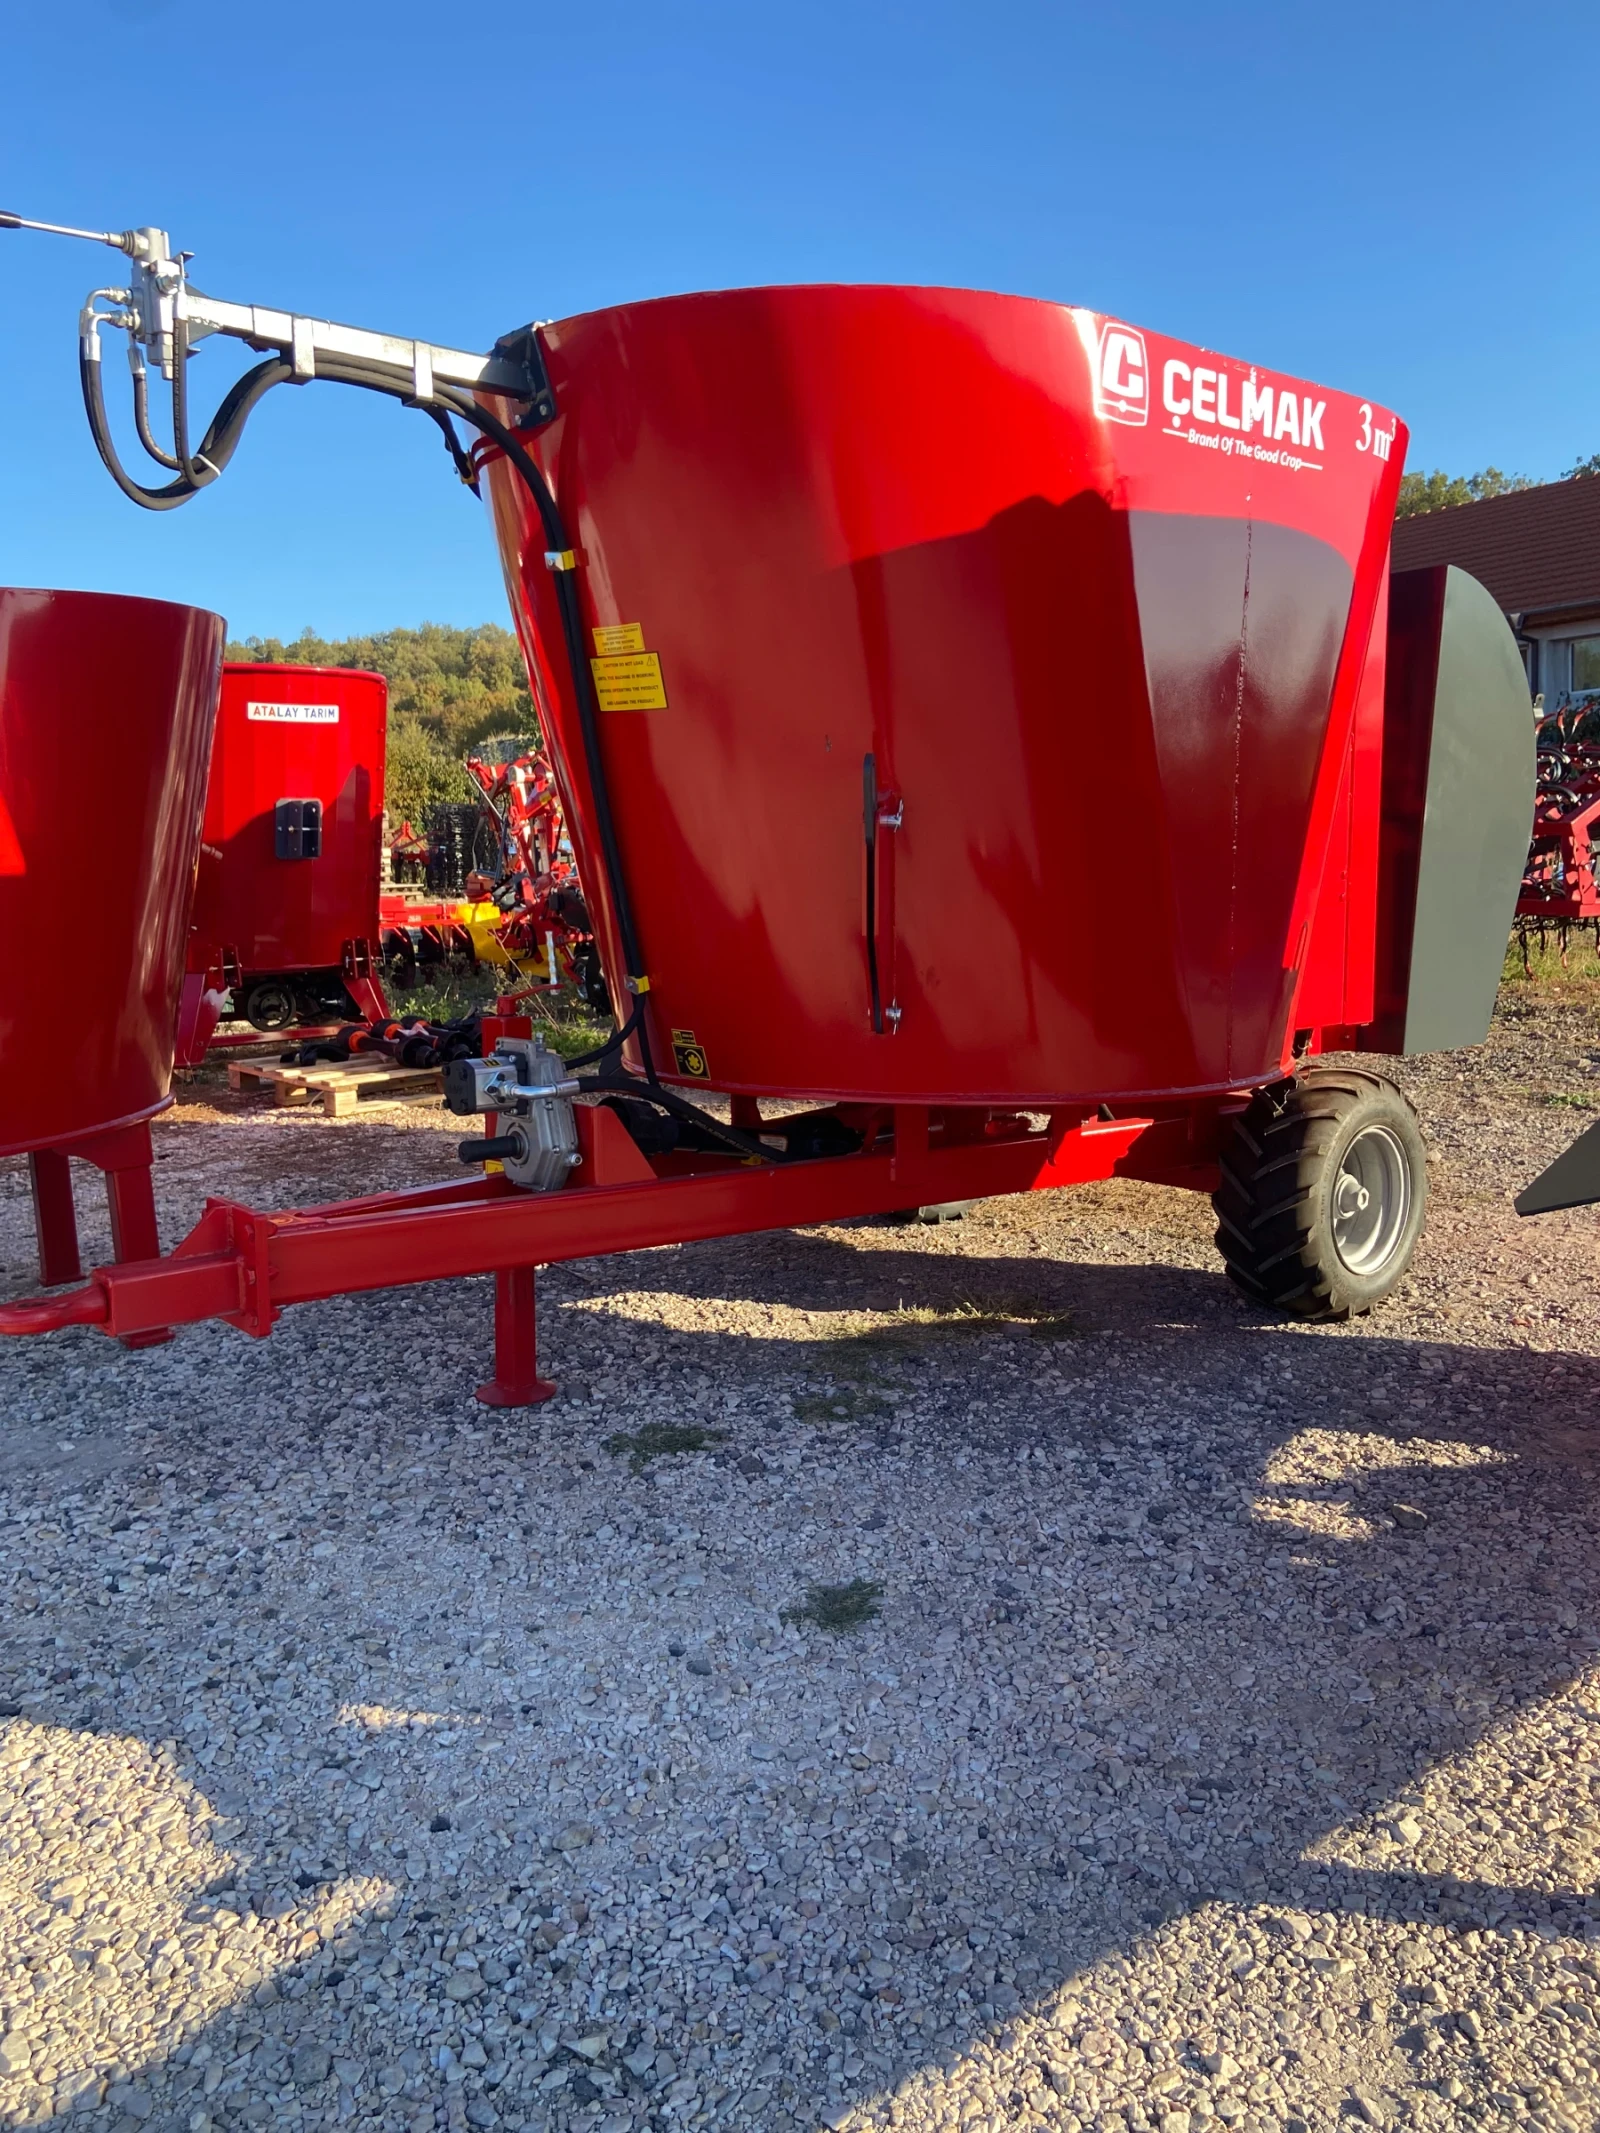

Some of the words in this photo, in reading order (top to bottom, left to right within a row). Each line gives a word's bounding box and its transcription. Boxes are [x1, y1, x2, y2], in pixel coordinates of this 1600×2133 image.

[1163, 359, 1326, 451] ÇELMAK
[1355, 403, 1373, 452] 3
[1188, 429, 1220, 449] Brand
[1221, 436, 1234, 456] Of
[1234, 440, 1253, 457] The
[1254, 445, 1279, 464] Good
[1280, 452, 1303, 472] Crop
[253, 705, 299, 718] ATALAY
[304, 707, 335, 719] TARIM
